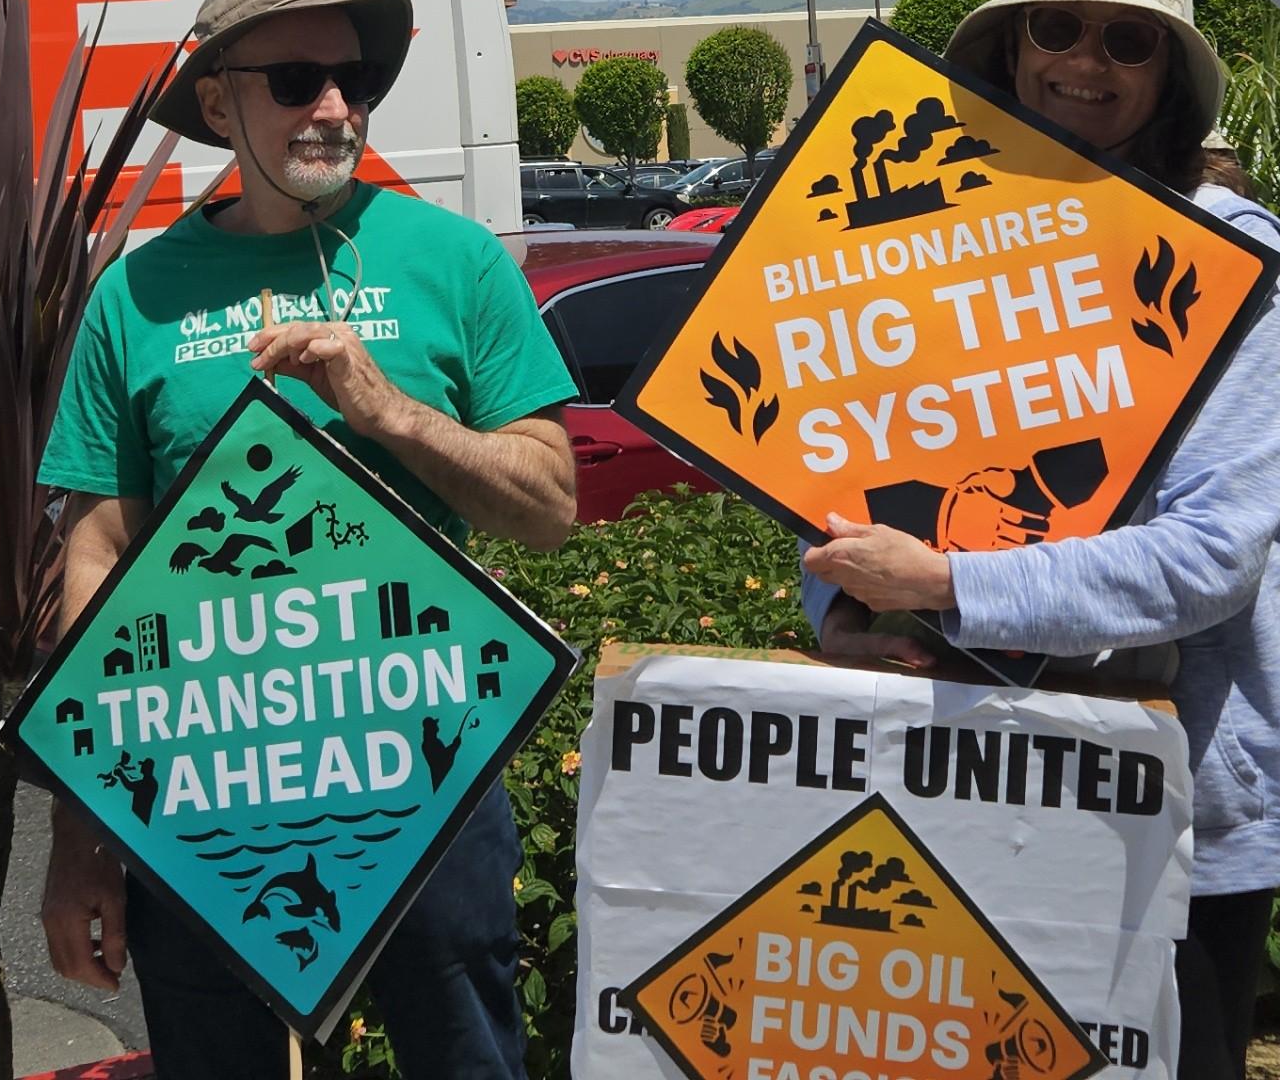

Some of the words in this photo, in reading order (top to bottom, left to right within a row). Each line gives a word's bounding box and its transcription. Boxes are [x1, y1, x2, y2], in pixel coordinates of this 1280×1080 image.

[567, 48, 601, 64] CVS
[762, 197, 1090, 304] BILLIONAIRES
[176, 334, 251, 362] PEOPL
[372, 322, 398, 338] IN
[179, 308, 222, 340] OIL
[332, 286, 392, 320] OUT
[773, 297, 916, 390] RIG
[931, 252, 1113, 351] THE
[797, 343, 1135, 475] SYSTEM
[177, 578, 368, 663] JUST
[96, 644, 467, 747] TRANSITION
[161, 729, 414, 816] AHEAD
[611, 699, 869, 794] PEOPLE
[902, 724, 1165, 817] UNITED
[753, 931, 861, 991] BIG
[879, 948, 975, 1010] OIL
[749, 994, 972, 1070] FUNDS
